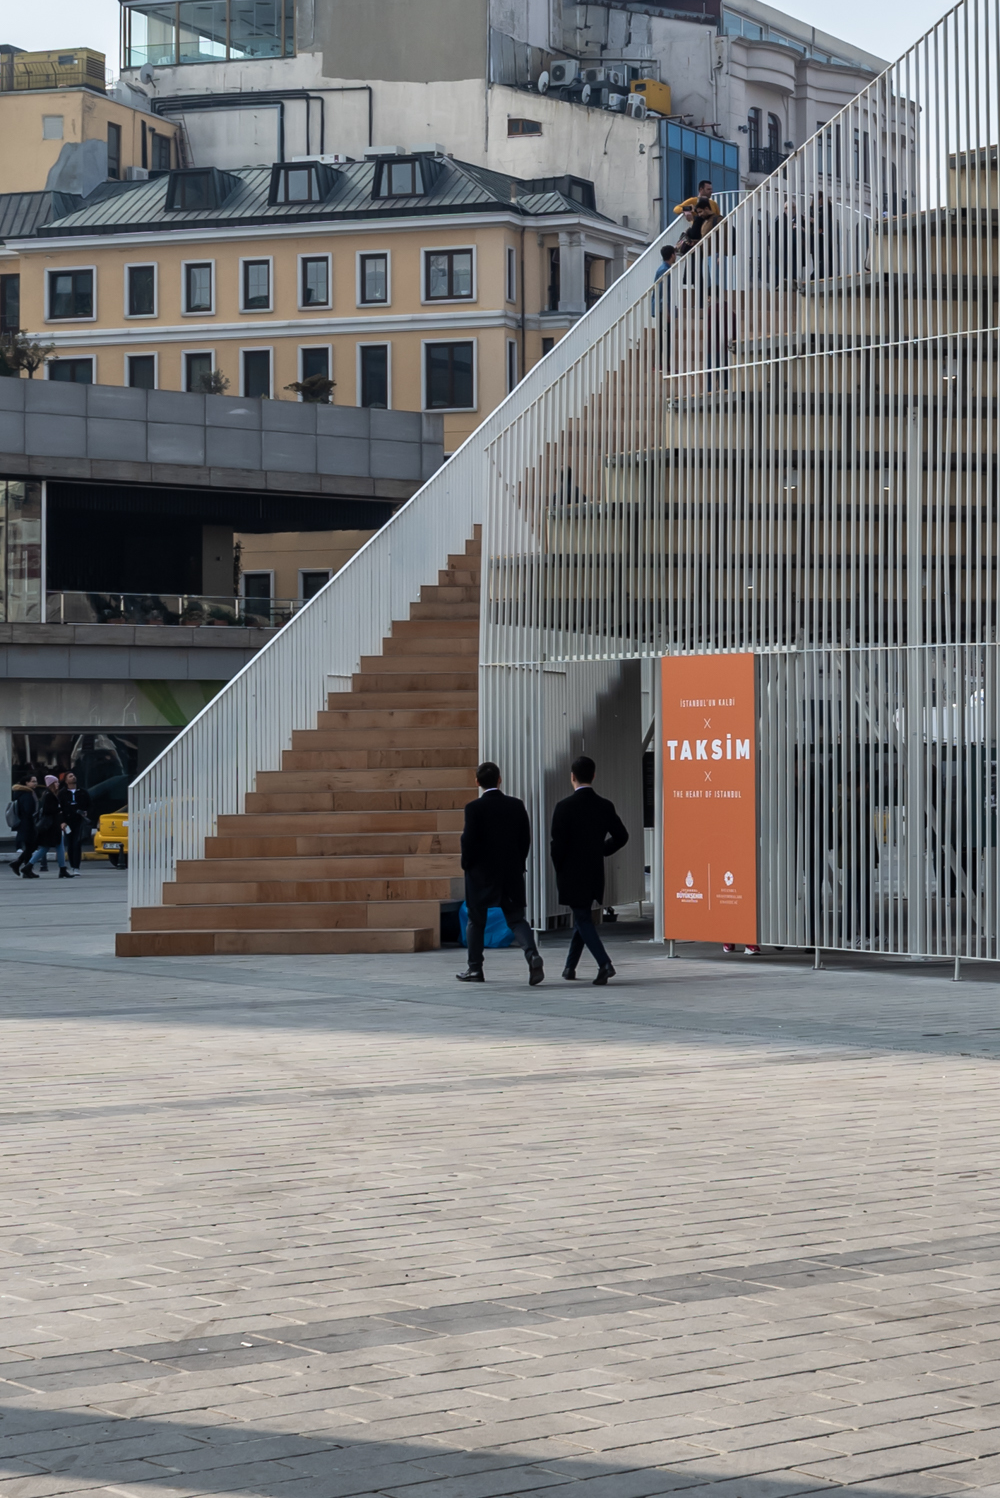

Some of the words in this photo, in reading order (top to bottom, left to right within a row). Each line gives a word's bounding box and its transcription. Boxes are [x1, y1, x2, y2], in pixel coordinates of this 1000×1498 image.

[666, 733, 750, 761] TAKSİM
[673, 790, 683, 798] THE
[685, 790, 703, 798] HEART
[705, 790, 712, 798] OF
